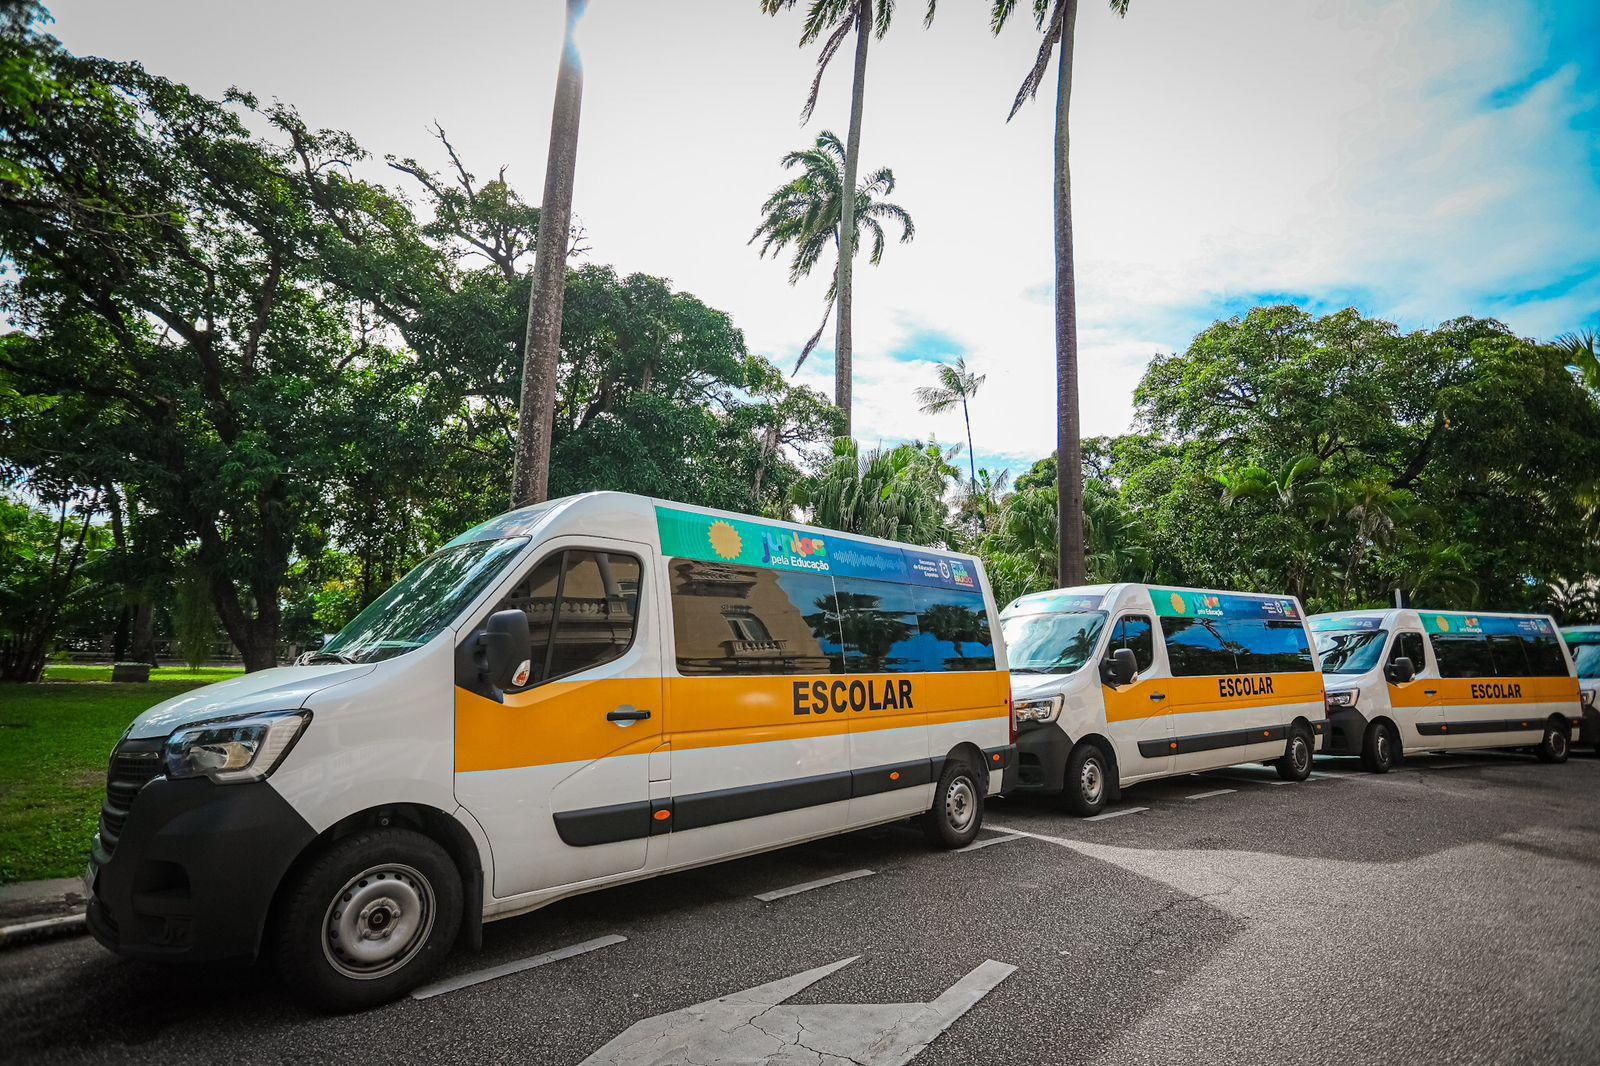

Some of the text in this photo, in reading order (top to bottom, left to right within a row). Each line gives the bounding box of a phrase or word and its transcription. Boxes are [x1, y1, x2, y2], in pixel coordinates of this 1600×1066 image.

[771, 555, 830, 571] pela Educação
[1218, 676, 1274, 697] ESCOLAR
[1471, 684, 1522, 699] ESCOLAR
[793, 679, 914, 716] ESCOLAR
